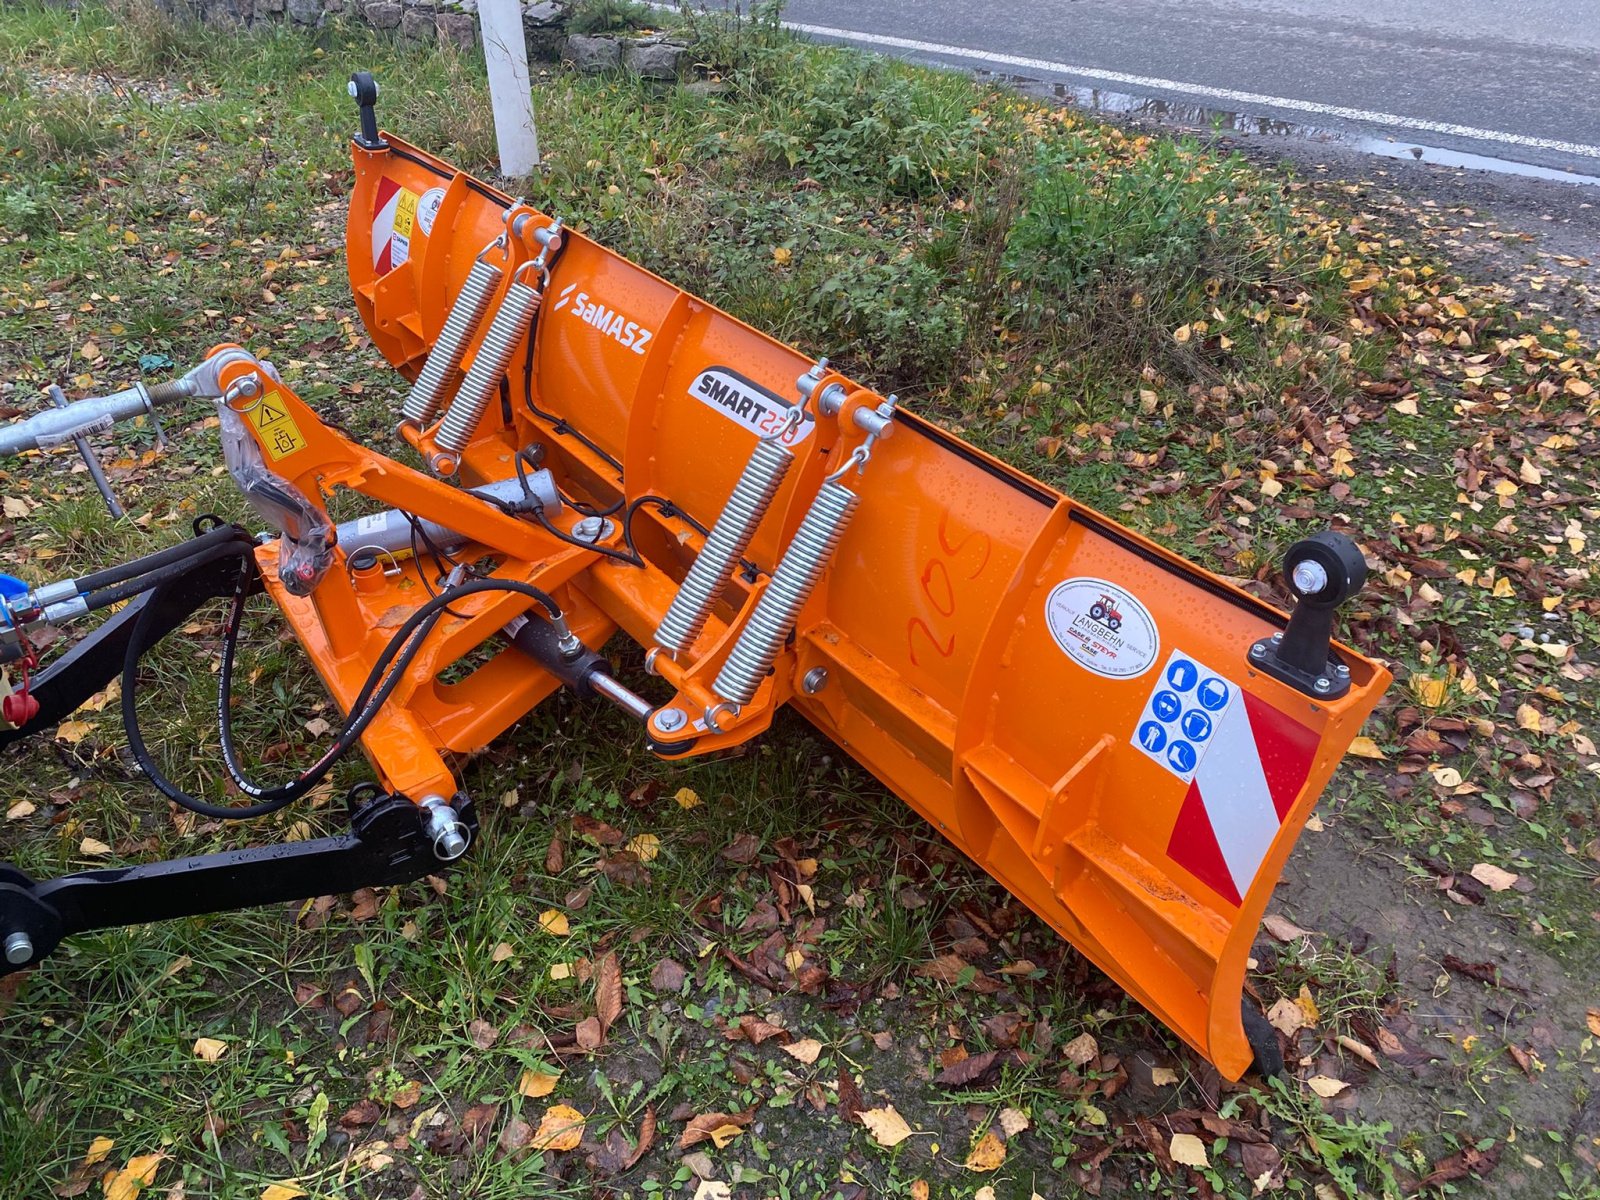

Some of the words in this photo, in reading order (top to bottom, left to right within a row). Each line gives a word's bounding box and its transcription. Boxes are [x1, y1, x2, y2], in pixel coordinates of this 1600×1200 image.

[571, 292, 653, 355] SaMASZ
[1072, 614, 1125, 648] LANGBEHN
[1081, 643, 1098, 656] CASE
[1091, 641, 1117, 660] STEYR
[1126, 643, 1147, 658] SERVICE
